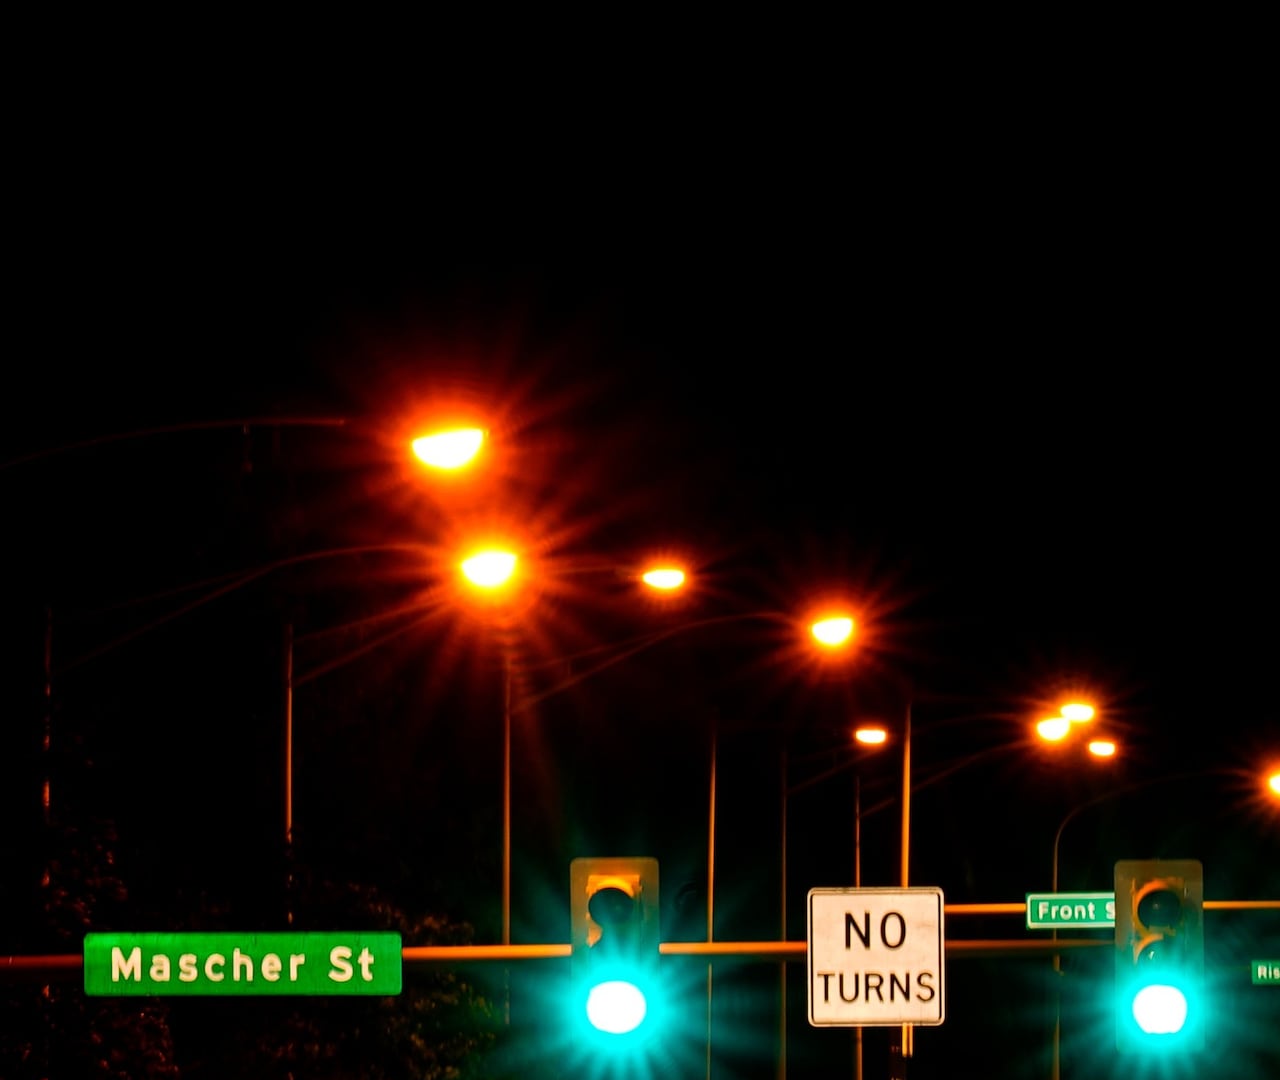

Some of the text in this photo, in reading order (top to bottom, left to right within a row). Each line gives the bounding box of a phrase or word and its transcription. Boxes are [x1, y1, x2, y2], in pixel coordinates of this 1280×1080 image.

[1038, 901, 1095, 920] Front
[845, 911, 907, 950] NO
[111, 945, 375, 982] Mascher St
[817, 971, 936, 1004] TURNS
